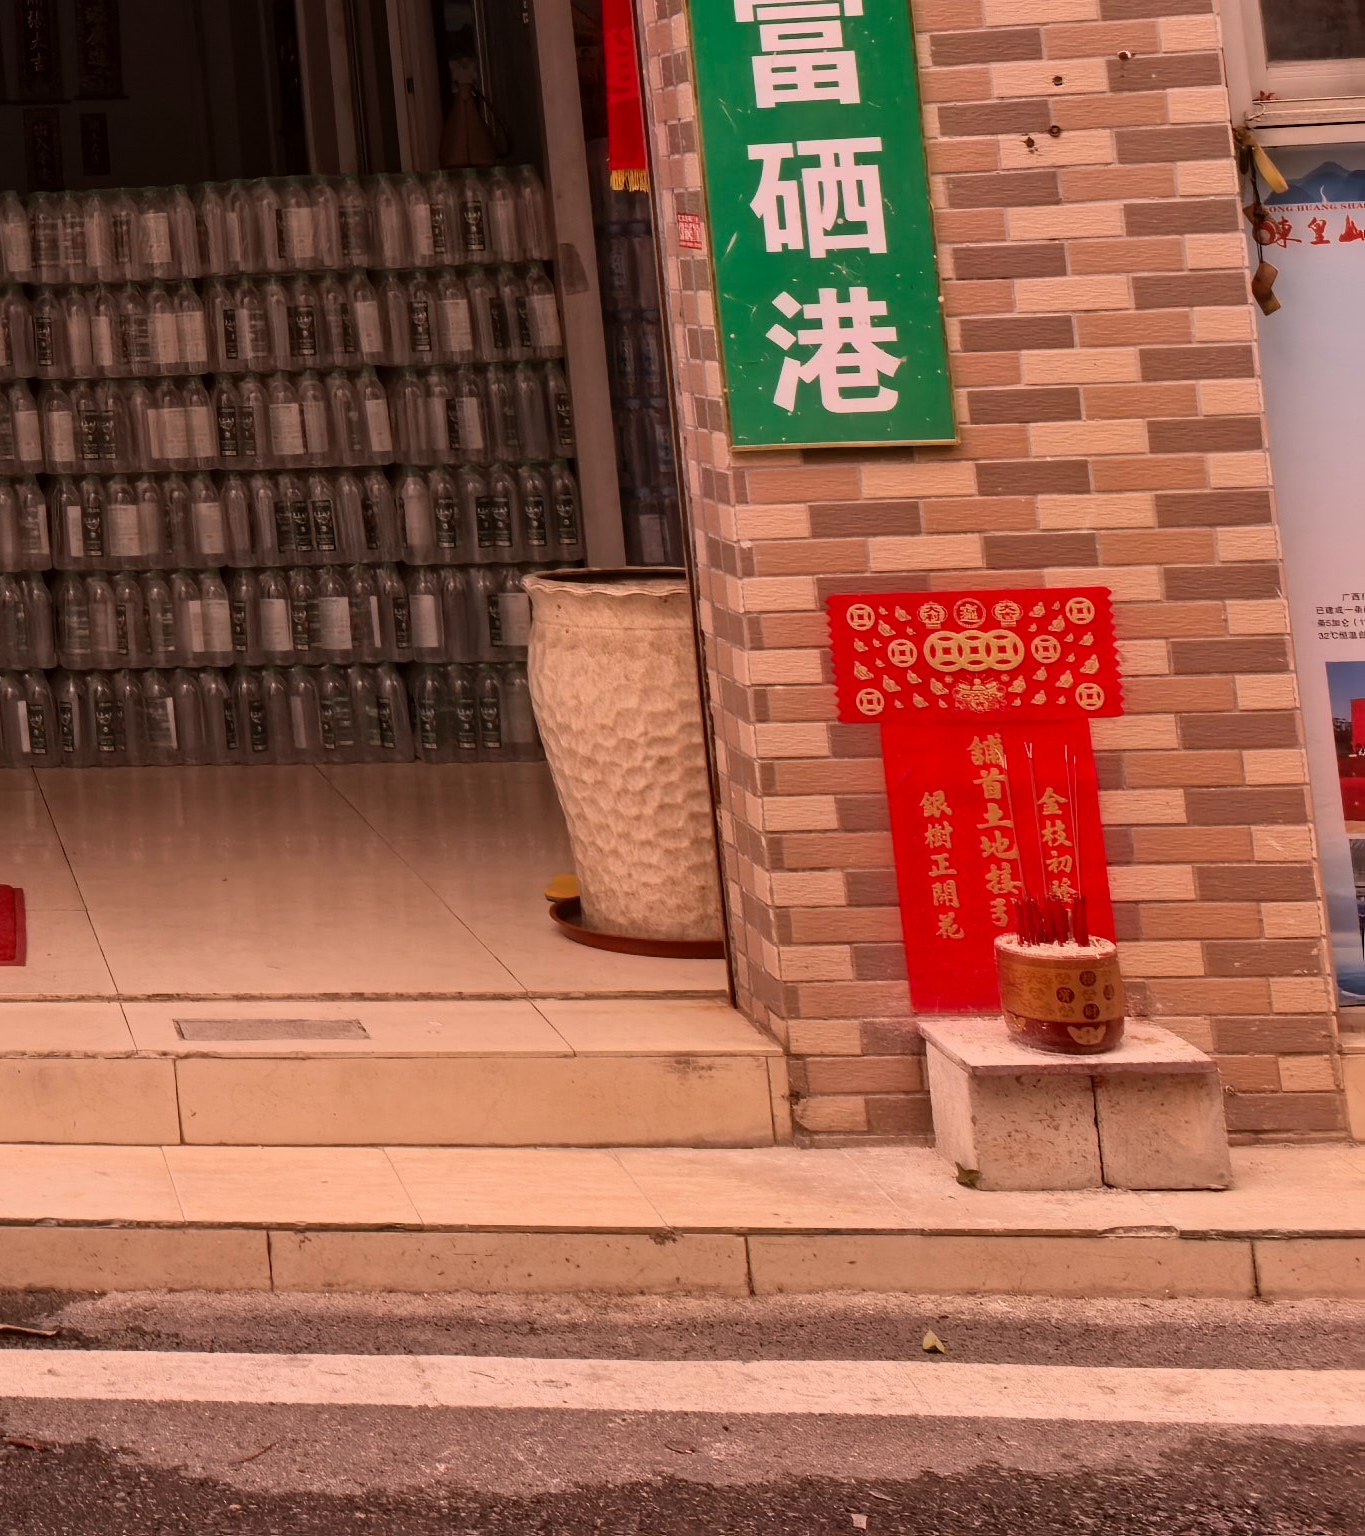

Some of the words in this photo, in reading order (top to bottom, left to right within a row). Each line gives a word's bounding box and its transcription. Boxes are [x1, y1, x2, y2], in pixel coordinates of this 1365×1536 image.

[1297, 204, 1337, 212] HUANG
[1272, 214, 1365, 249] 東皇山
[1341, 592, 1365, 602] 广西
[1315, 605, 1365, 615] 已建成一条
